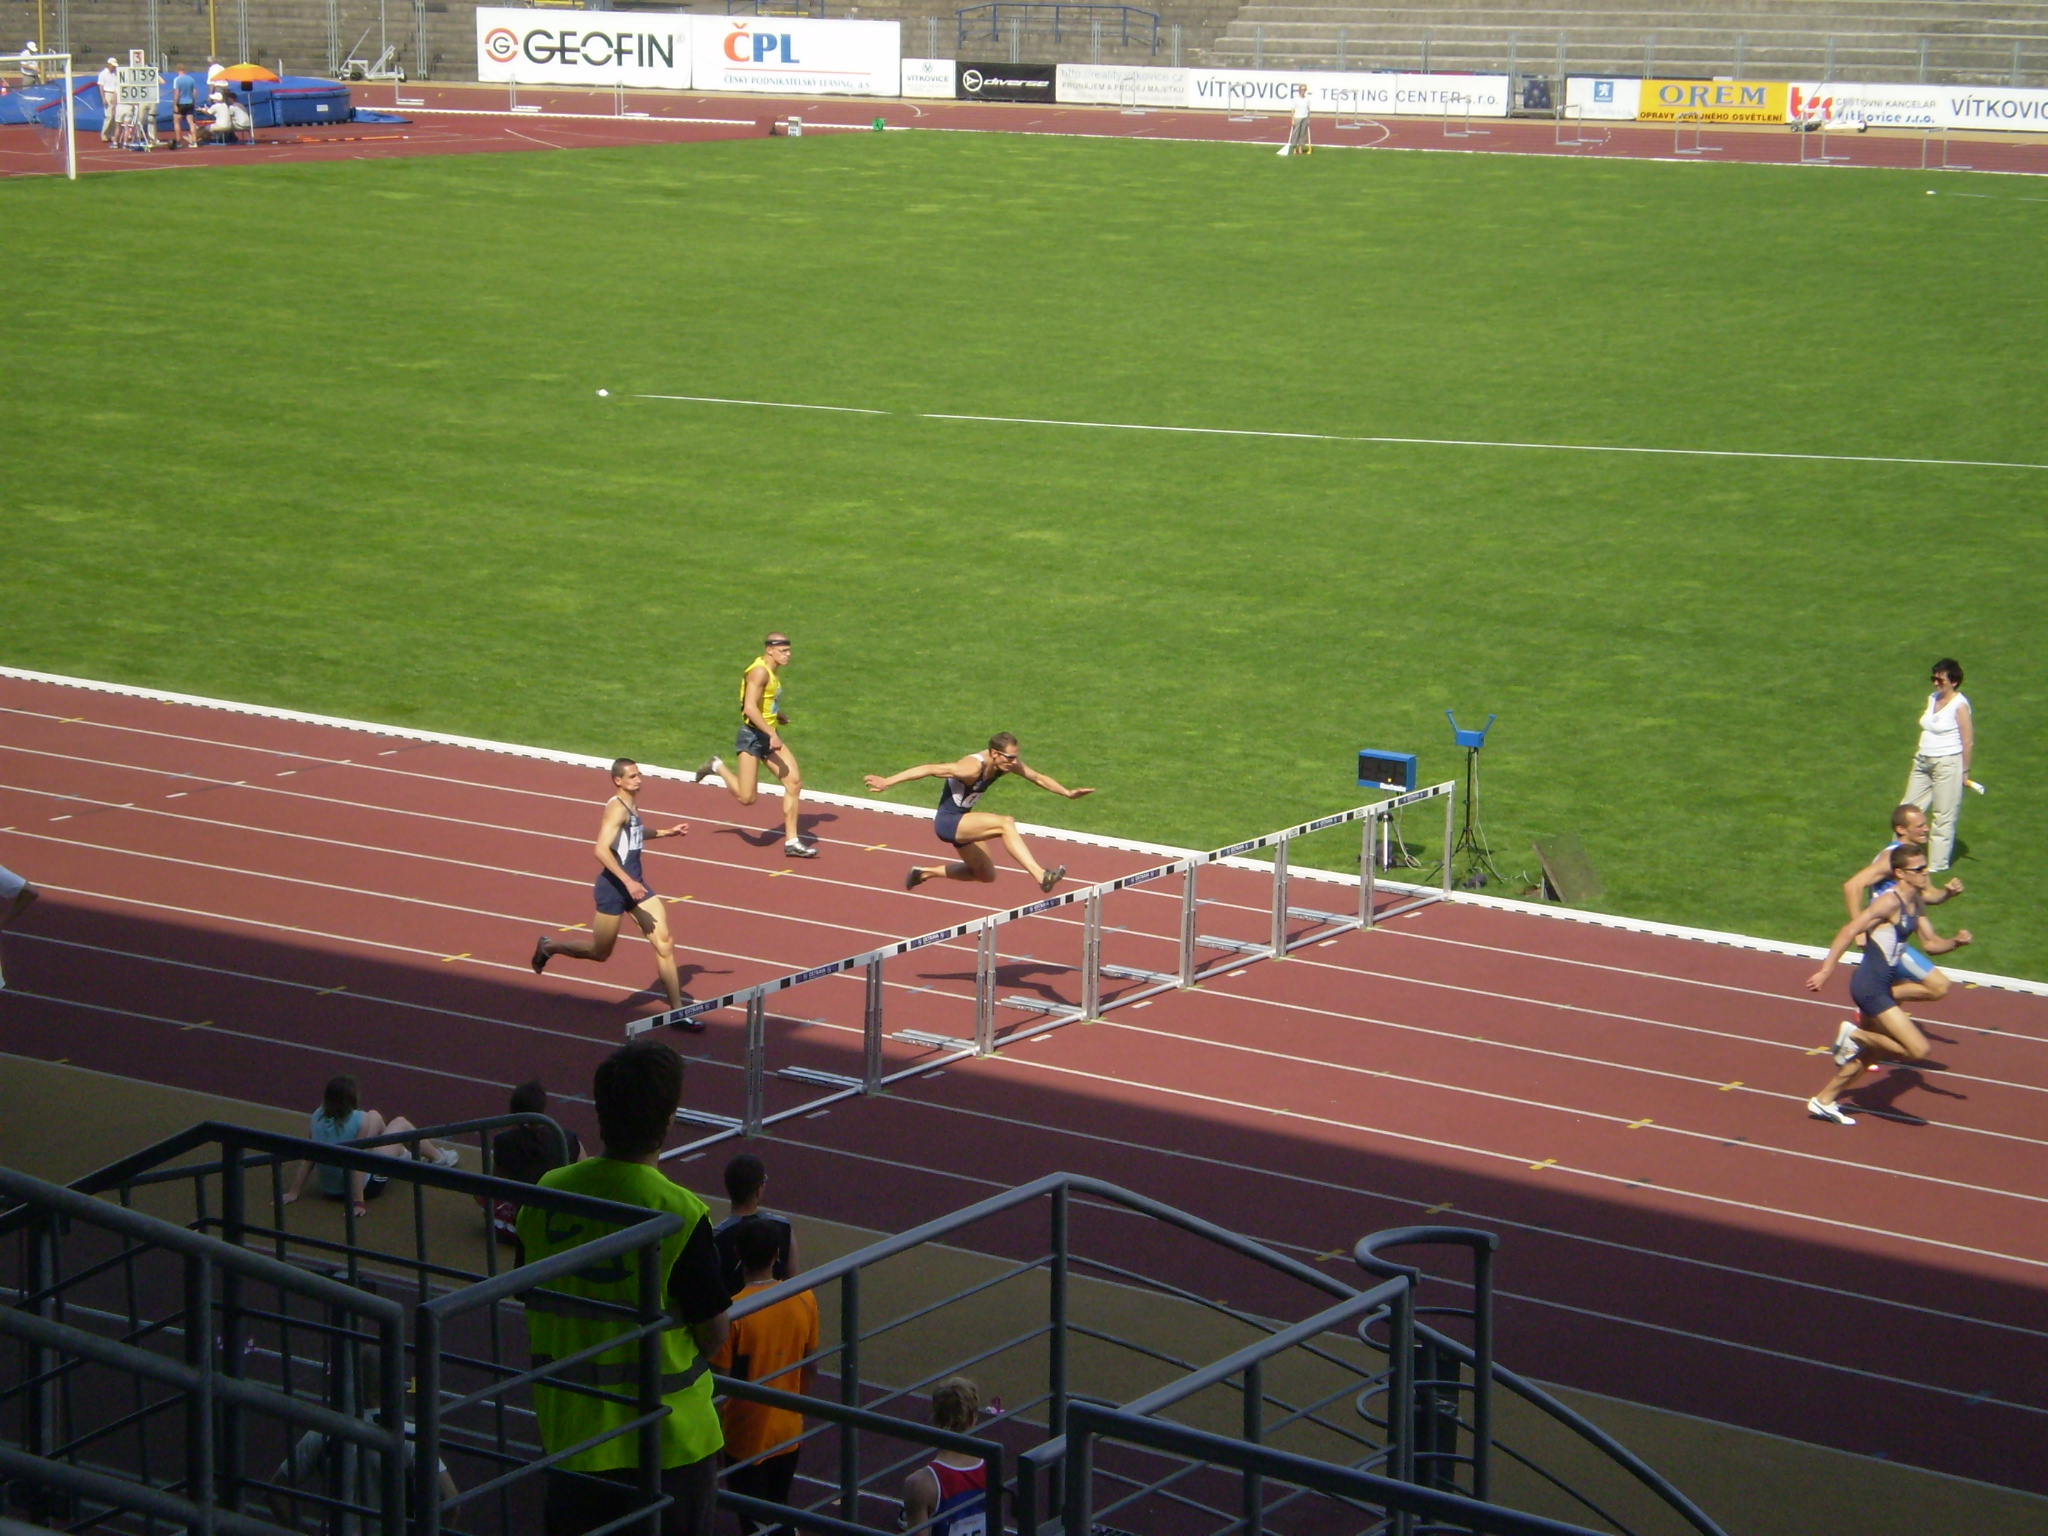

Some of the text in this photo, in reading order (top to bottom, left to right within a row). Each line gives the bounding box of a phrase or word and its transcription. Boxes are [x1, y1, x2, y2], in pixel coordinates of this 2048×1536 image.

[523, 28, 674, 68] GEOFIN
[724, 22, 800, 64] ČPL
[133, 51, 142, 64] 3
[131, 69, 156, 82] 139
[121, 86, 148, 99] 505
[1321, 88, 1388, 102] TESTING
[1396, 90, 1461, 104] CENTER
[1659, 84, 1767, 107] OREM
[1640, 111, 1675, 119] OPRAVY
[1732, 112, 1783, 122] OSVĚTLENÍ
